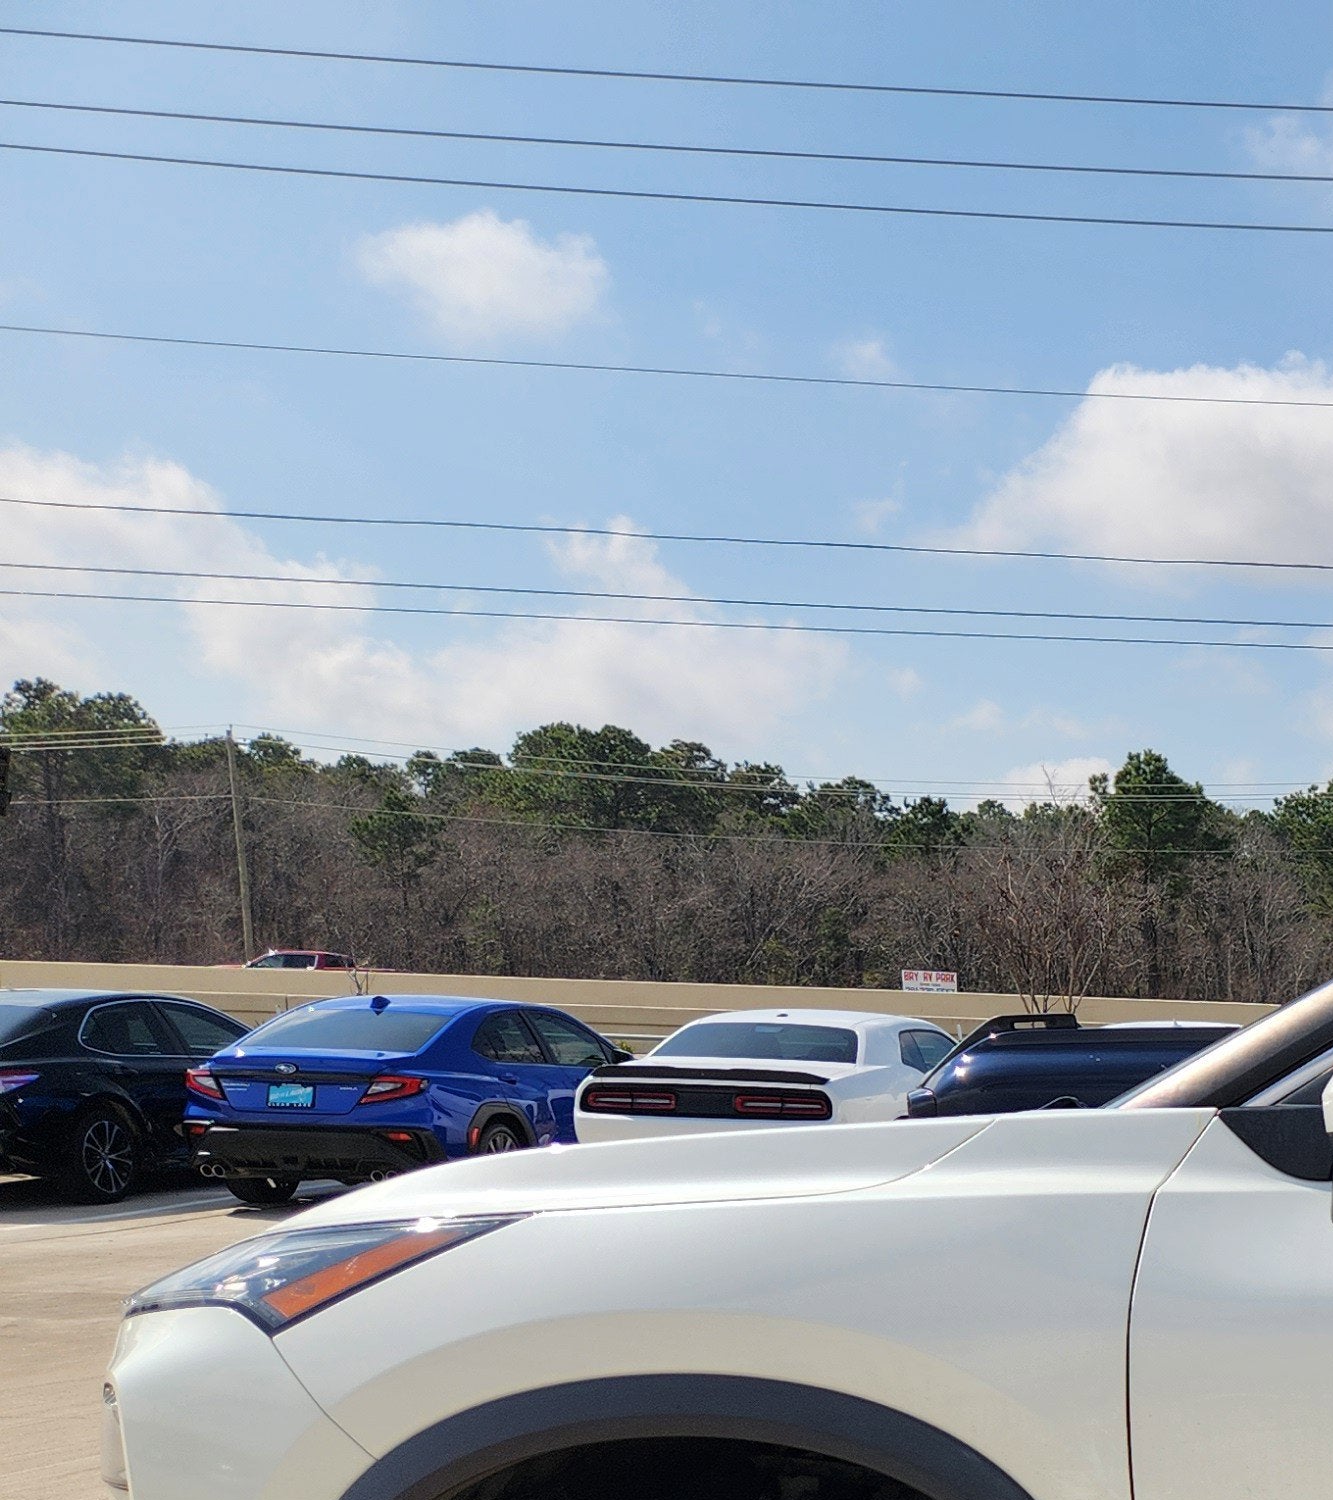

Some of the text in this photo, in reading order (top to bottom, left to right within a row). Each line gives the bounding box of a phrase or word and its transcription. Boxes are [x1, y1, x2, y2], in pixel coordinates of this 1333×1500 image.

[903, 971, 955, 983] BAY RV PARK
